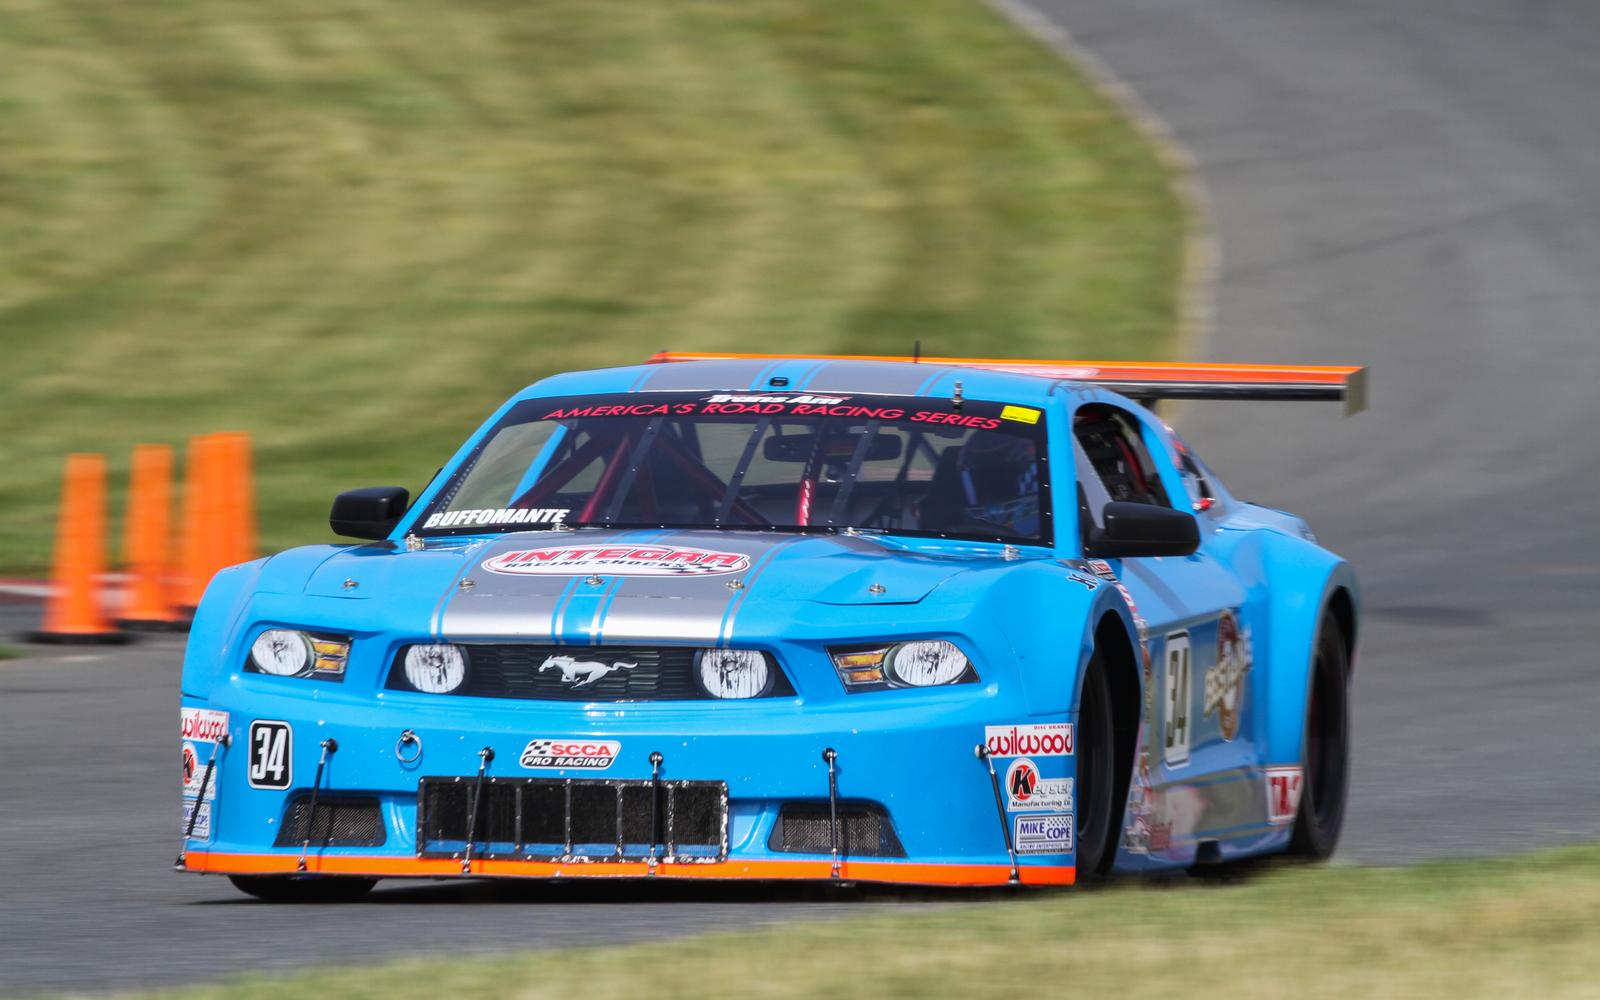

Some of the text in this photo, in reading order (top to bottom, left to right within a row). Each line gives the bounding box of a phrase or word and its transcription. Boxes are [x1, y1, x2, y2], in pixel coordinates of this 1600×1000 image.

[707, 394, 844, 405] Trans Am
[541, 403, 697, 420] AMERICA'S
[700, 403, 785, 414] ROAD
[790, 404, 905, 419] RACING
[910, 411, 1003, 430] SERIES
[422, 508, 571, 529] BUFFOMANTE
[500, 548, 745, 566] INTEGRA
[503, 560, 589, 568] RACING
[988, 724, 1073, 755] wilwood
[251, 726, 288, 781] 34
[551, 744, 612, 756] SCCA
[523, 757, 610, 766] PRO RACING
[1012, 799, 1062, 808] Manufacturing
[1020, 822, 1045, 835] MIKE
[1046, 827, 1070, 839] COPE
